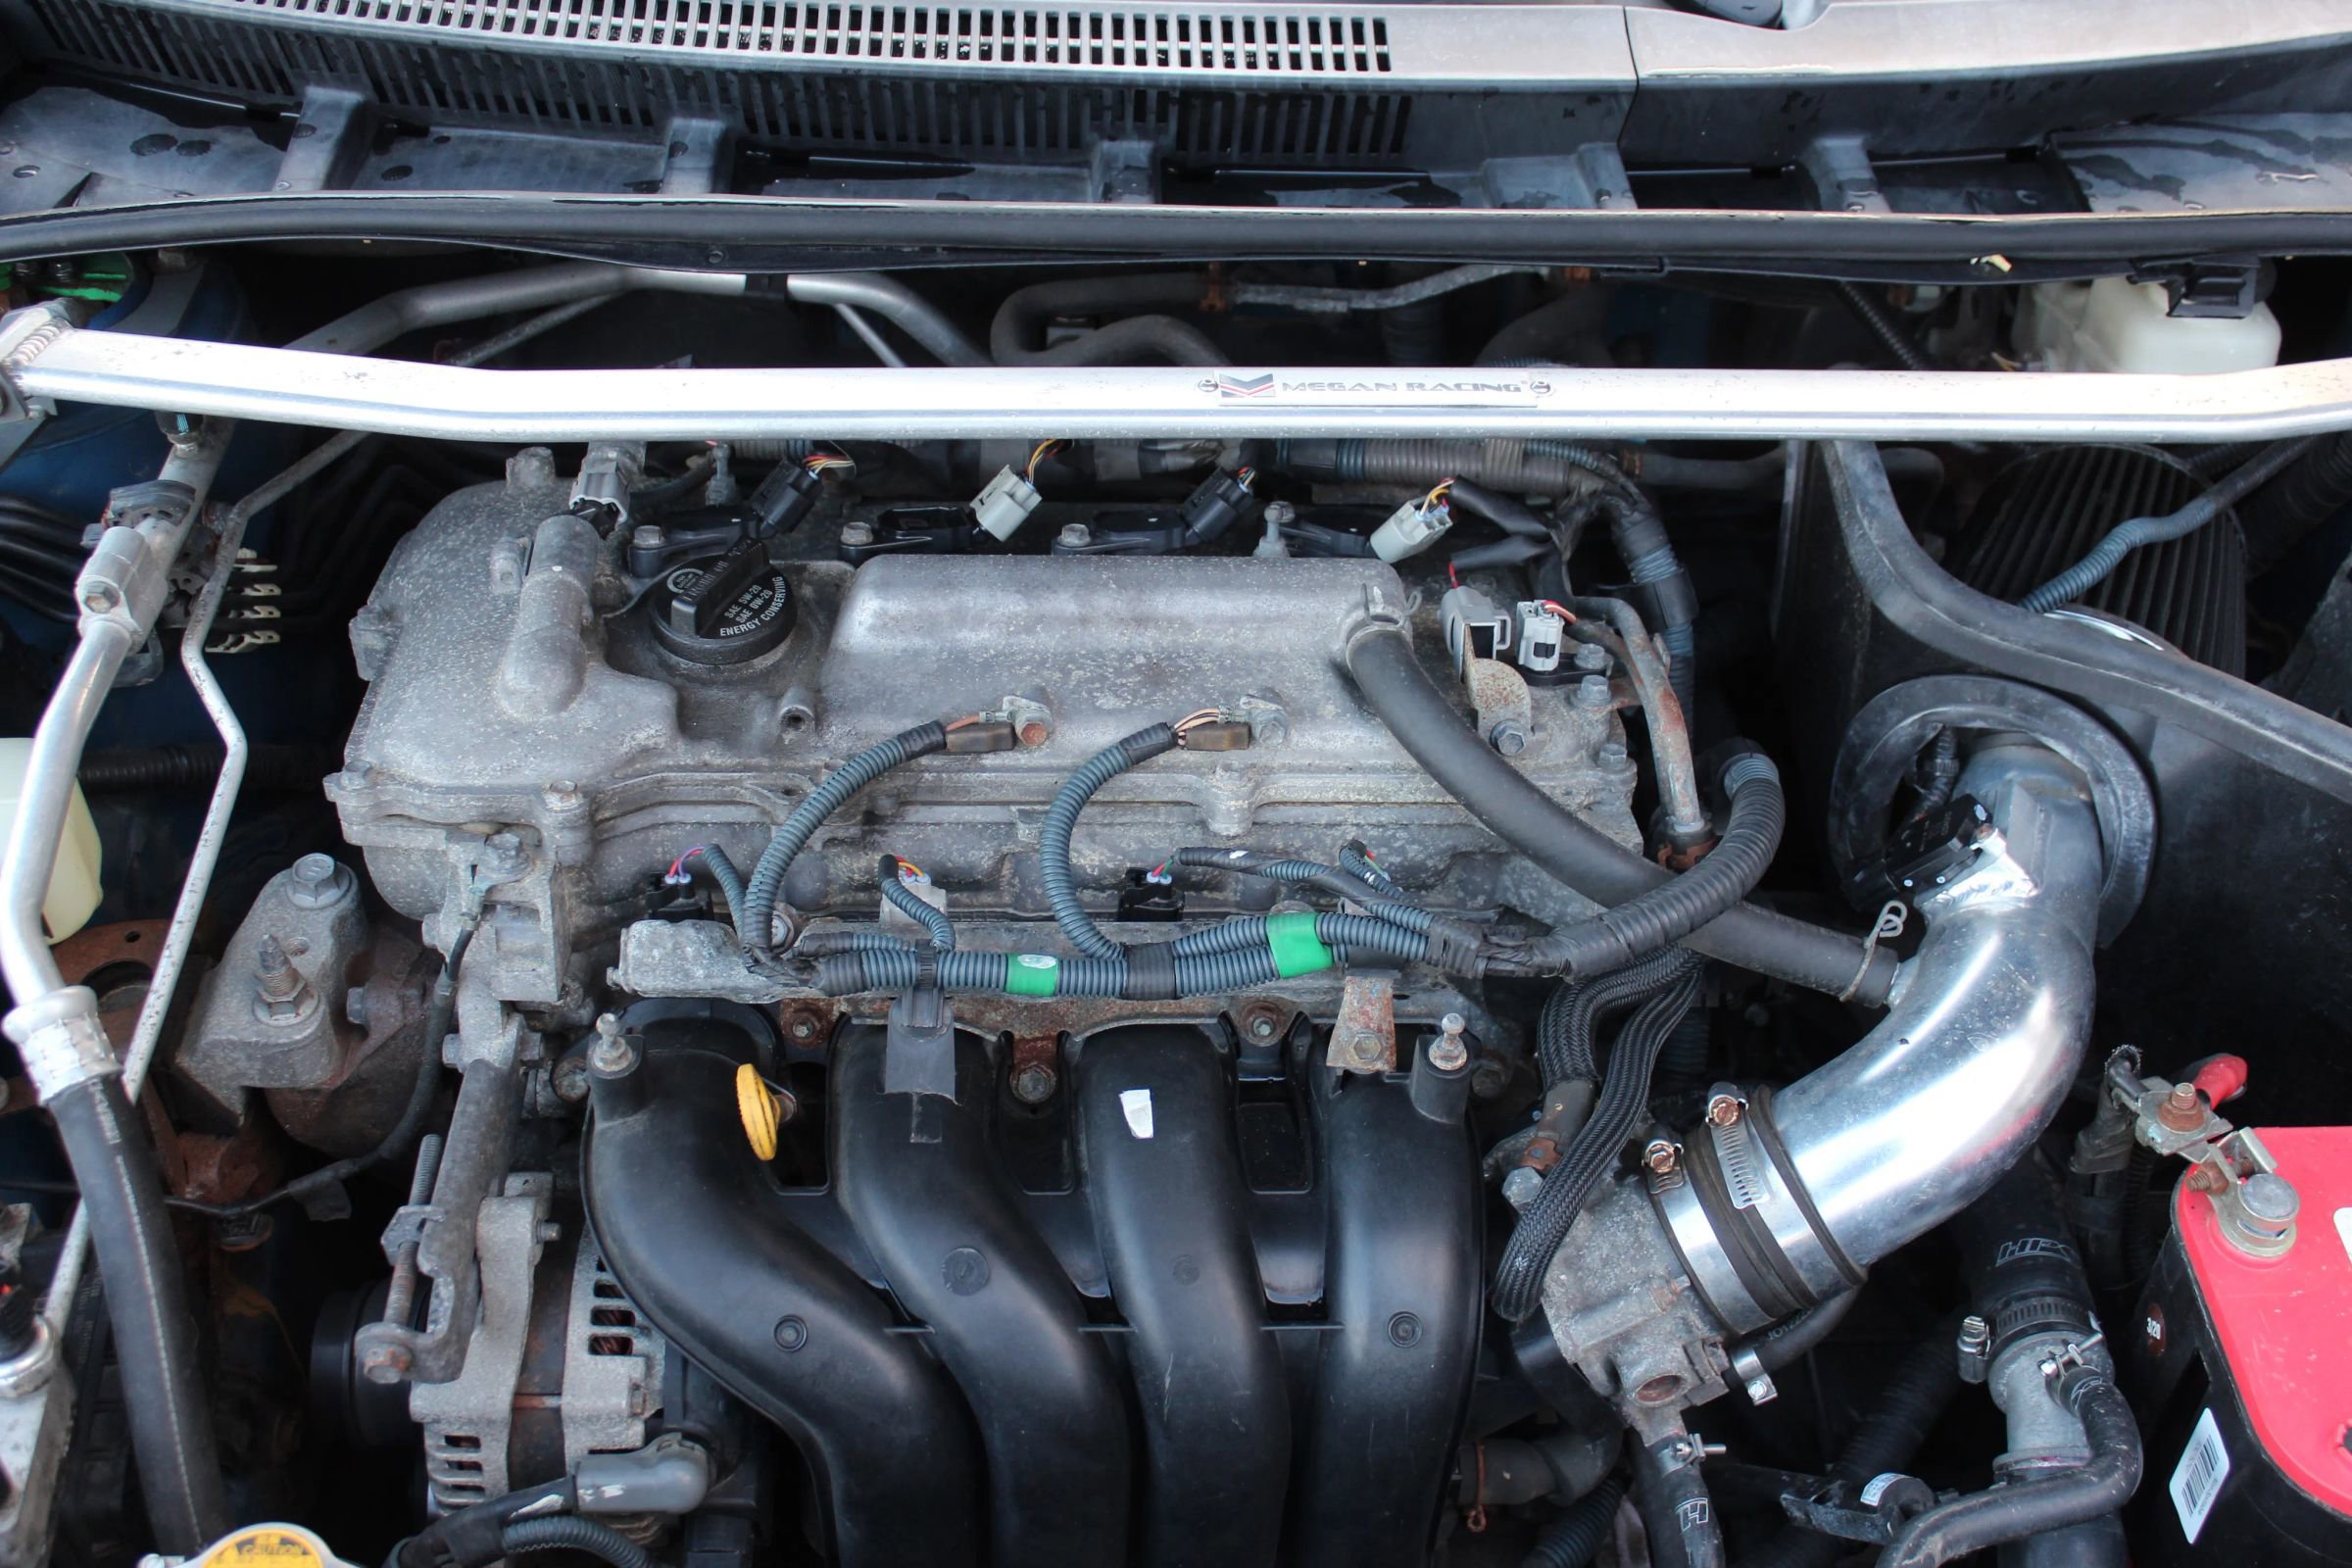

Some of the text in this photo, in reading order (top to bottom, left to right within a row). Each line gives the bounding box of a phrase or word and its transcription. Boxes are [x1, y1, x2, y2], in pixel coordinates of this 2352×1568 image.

[1282, 381, 1522, 393] MEGAN RACING
[719, 576, 786, 637] ENERGY CONSERVING
[724, 584, 762, 618] SAE 5W-20
[735, 589, 773, 623] SAE 0W-20
